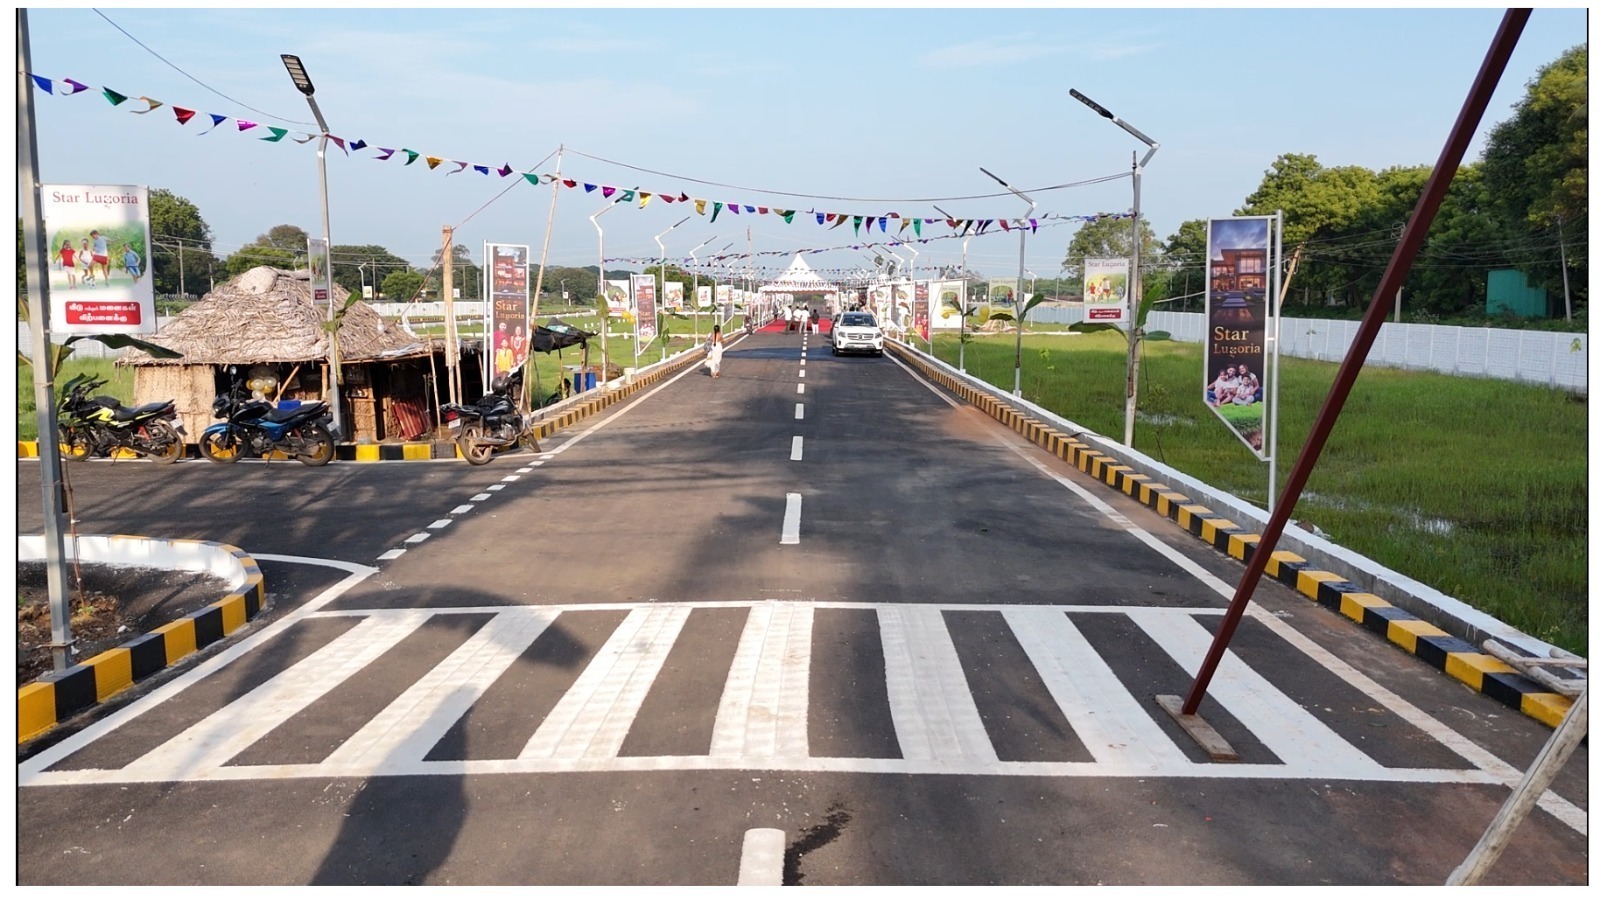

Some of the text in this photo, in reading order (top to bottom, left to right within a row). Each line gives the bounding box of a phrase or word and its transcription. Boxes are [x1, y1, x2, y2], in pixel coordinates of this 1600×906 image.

[53, 191, 80, 203] Star
[495, 299, 518, 311] Star
[1214, 326, 1250, 341] Star
